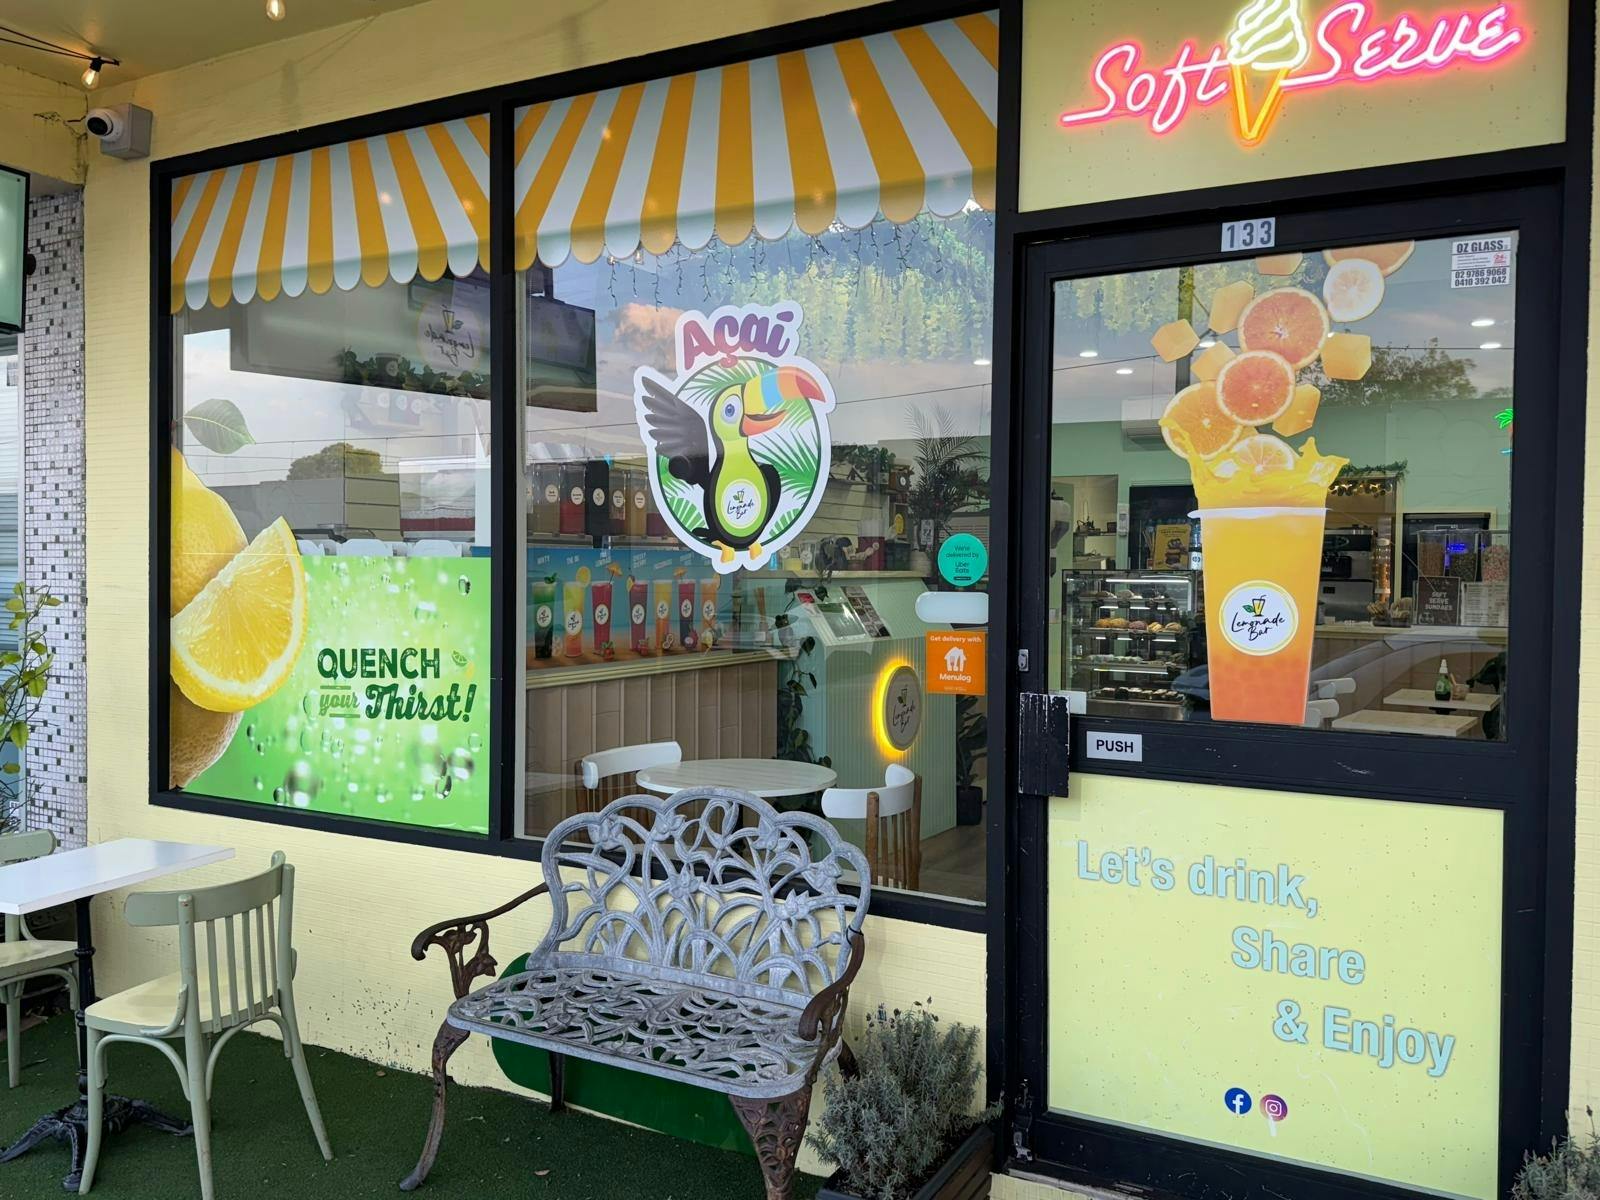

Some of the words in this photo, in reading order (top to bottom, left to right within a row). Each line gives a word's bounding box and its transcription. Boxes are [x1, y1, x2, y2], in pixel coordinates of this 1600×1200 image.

[1060, 43, 1231, 134] Soft
[1226, 220, 1272, 249] 133
[1456, 242, 1469, 254] OZ
[1471, 239, 1504, 252] GLASS
[1454, 270, 1465, 279] 02
[1474, 276, 1490, 286] 392
[1491, 275, 1507, 284] 042
[1231, 611, 1286, 633] Lemonade
[942, 635, 967, 644] delivery
[317, 647, 440, 681] QUENCH
[939, 672, 972, 684] Menulog
[318, 691, 361, 717] your
[364, 682, 478, 723] Thirst!
[1095, 739, 1135, 755] PUSH
[1076, 839, 1176, 892] Let's
[1188, 854, 1319, 918] drink,
[1231, 926, 1366, 986] Share
[1272, 998, 1309, 1045] &
[1322, 1006, 1456, 1078] Enjoy
